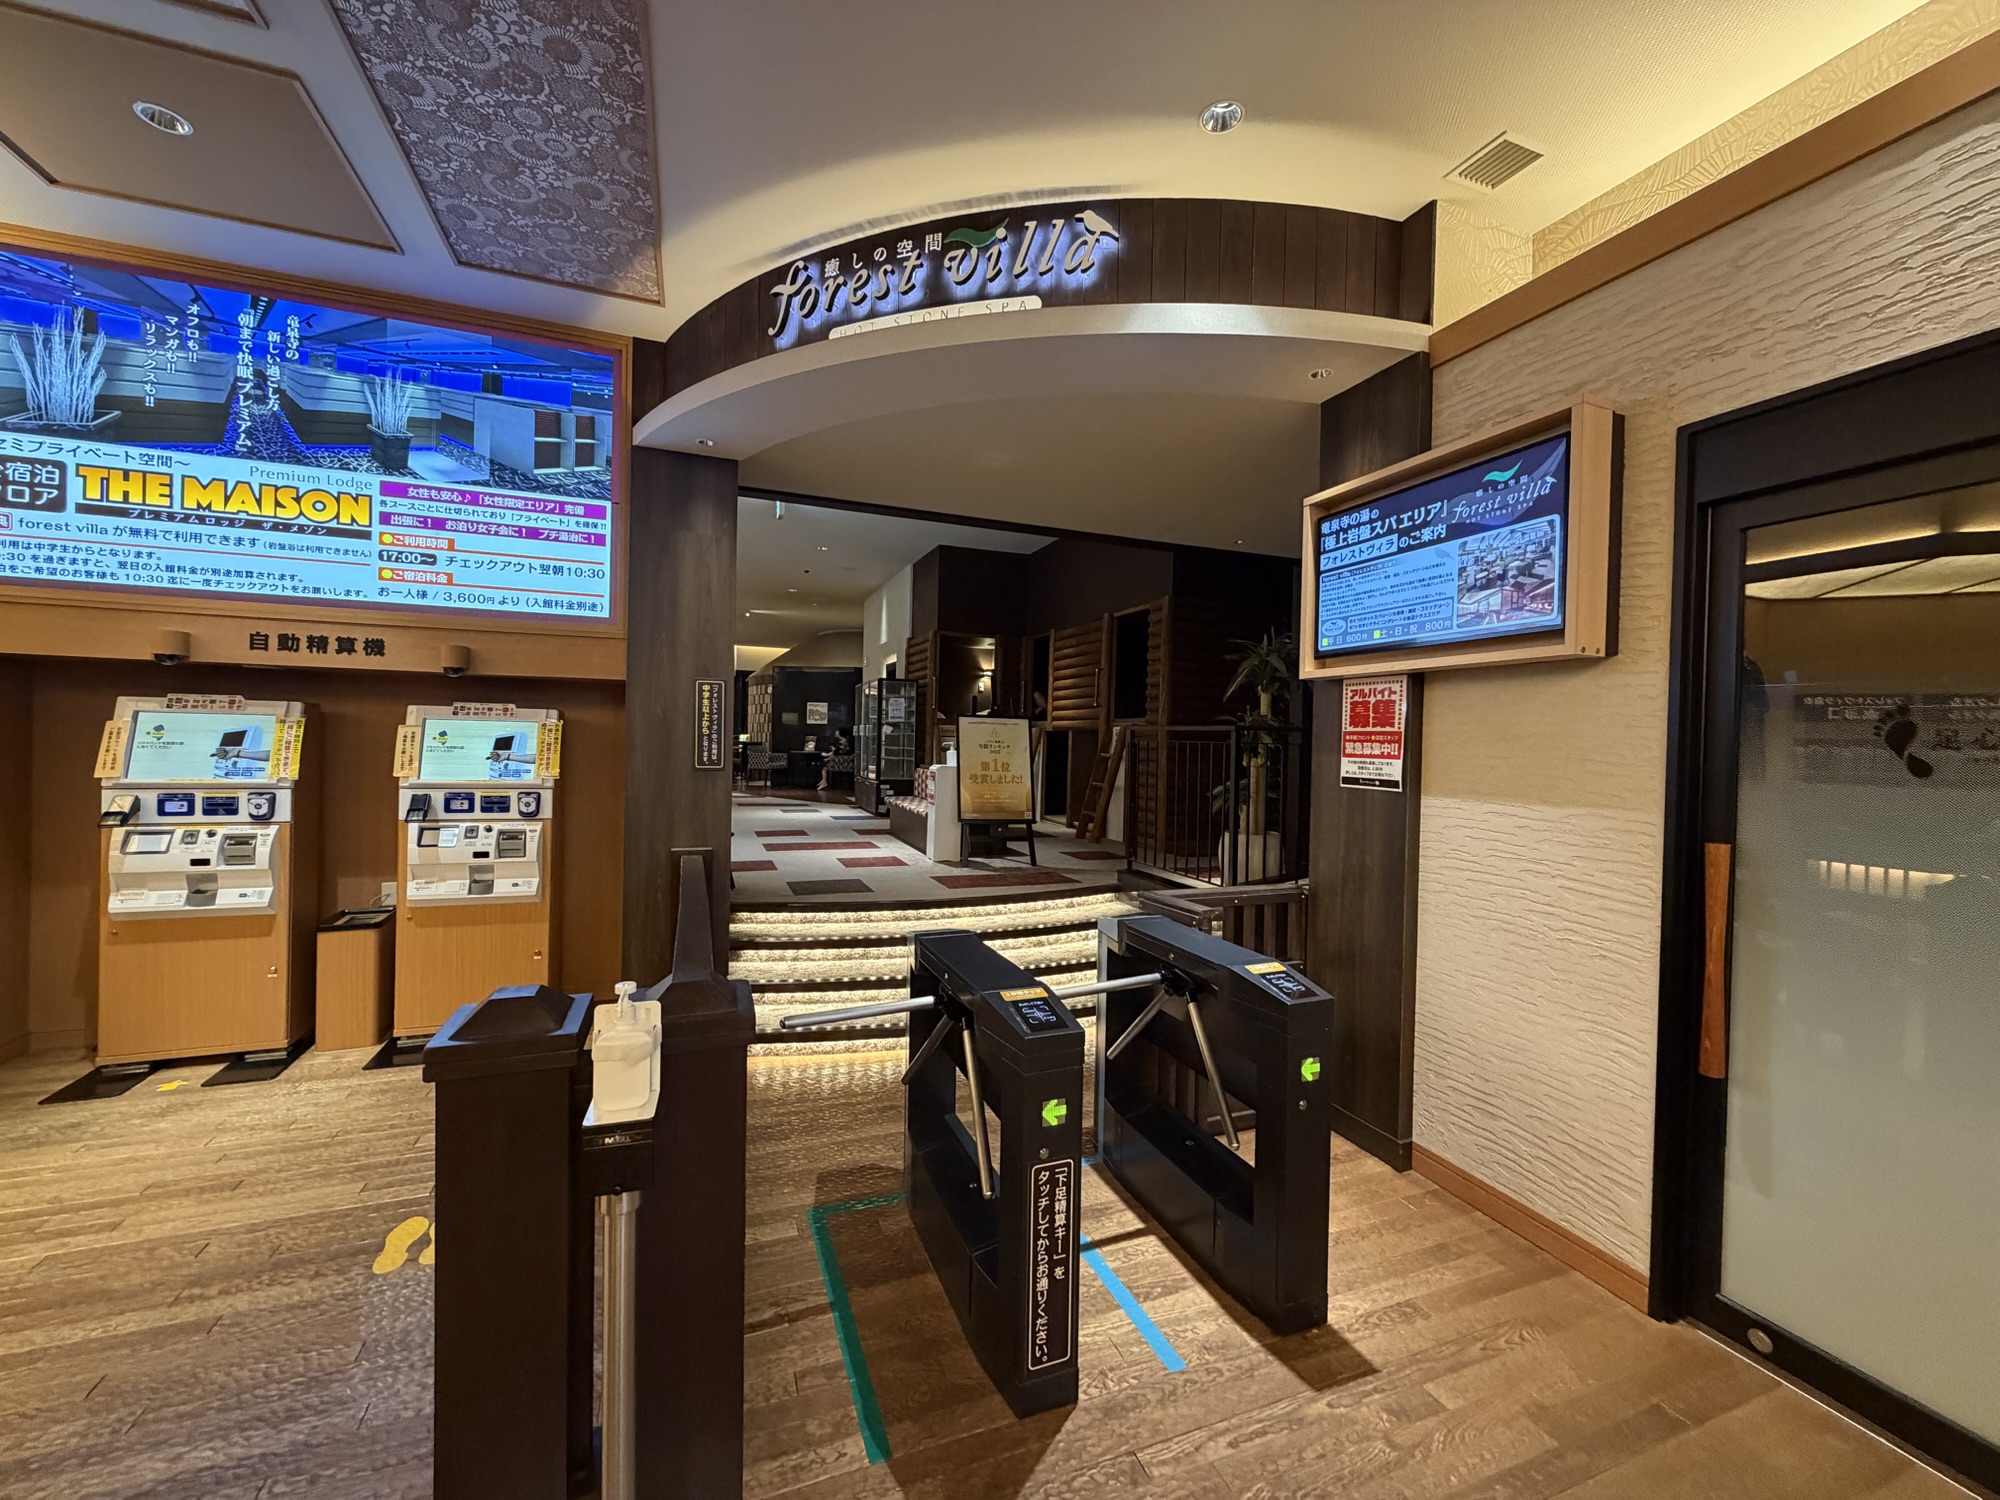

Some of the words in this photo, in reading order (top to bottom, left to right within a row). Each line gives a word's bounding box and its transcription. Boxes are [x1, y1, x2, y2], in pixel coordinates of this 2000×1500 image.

[824, 232, 942, 278] 癒しの空間
[768, 249, 924, 337] forest
[943, 218, 1097, 285] villa
[986, 300, 1028, 314] SPA
[266, 330, 281, 411] 新しい過ごし方
[0, 462, 60, 485] 宿泊
[249, 465, 321, 485] Premium
[327, 473, 373, 491] Lodge
[0, 485, 59, 505] ロア
[77, 464, 173, 508] THE
[182, 474, 372, 528] MAISON
[1452, 495, 1502, 524] forest
[1507, 479, 1551, 505] villa
[18, 517, 71, 532] forest
[75, 523, 109, 535] villa
[113, 525, 261, 548] が無料で利用できます
[0, 552, 26, 566] :30
[1322, 538, 1395, 568] フォレストヴィラ
[124, 573, 164, 585] 10:30
[249, 632, 386, 657] 自動精算機
[1350, 686, 1397, 700] アルバイト
[1349, 699, 1397, 729] 募集
[1345, 741, 1399, 756] 緊急募集中!!
[980, 758, 1011, 773] 第1位
[969, 773, 1023, 785] 受賞しました!
[1035, 1170, 1050, 1362] タッチしてからお通りください。
